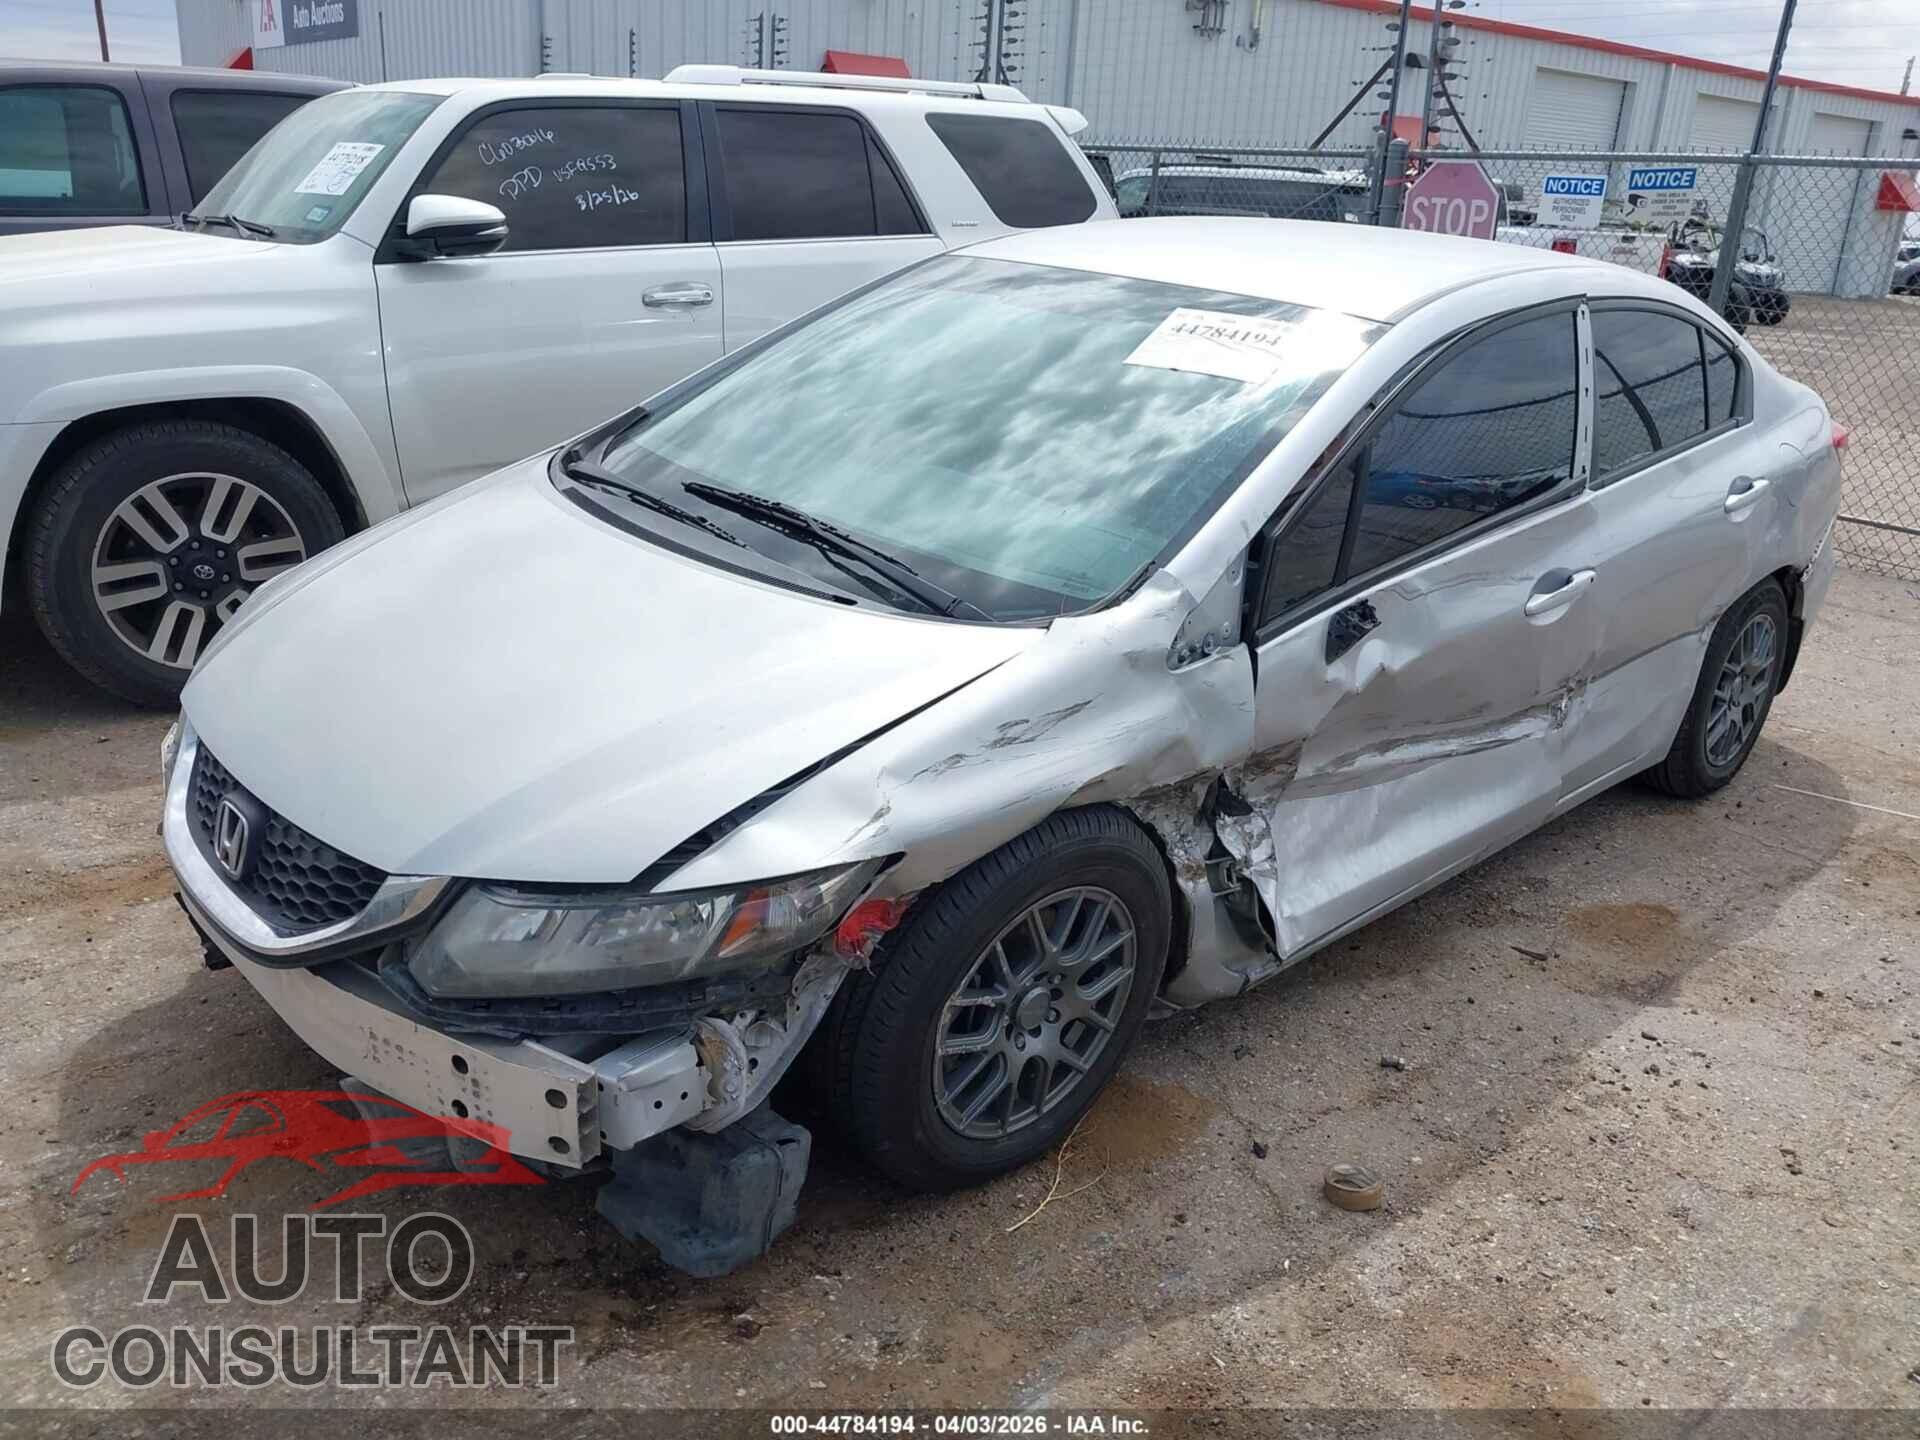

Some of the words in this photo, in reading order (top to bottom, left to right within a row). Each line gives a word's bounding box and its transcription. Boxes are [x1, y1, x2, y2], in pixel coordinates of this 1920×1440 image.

[311, 0, 344, 26] Auctions
[1547, 178, 1602, 194] NOTICE
[1631, 170, 1694, 188] NOTICE
[575, 184, 639, 211] 3/25/26
[1409, 196, 1489, 237] STOP
[1171, 323, 1282, 346] 44784194
